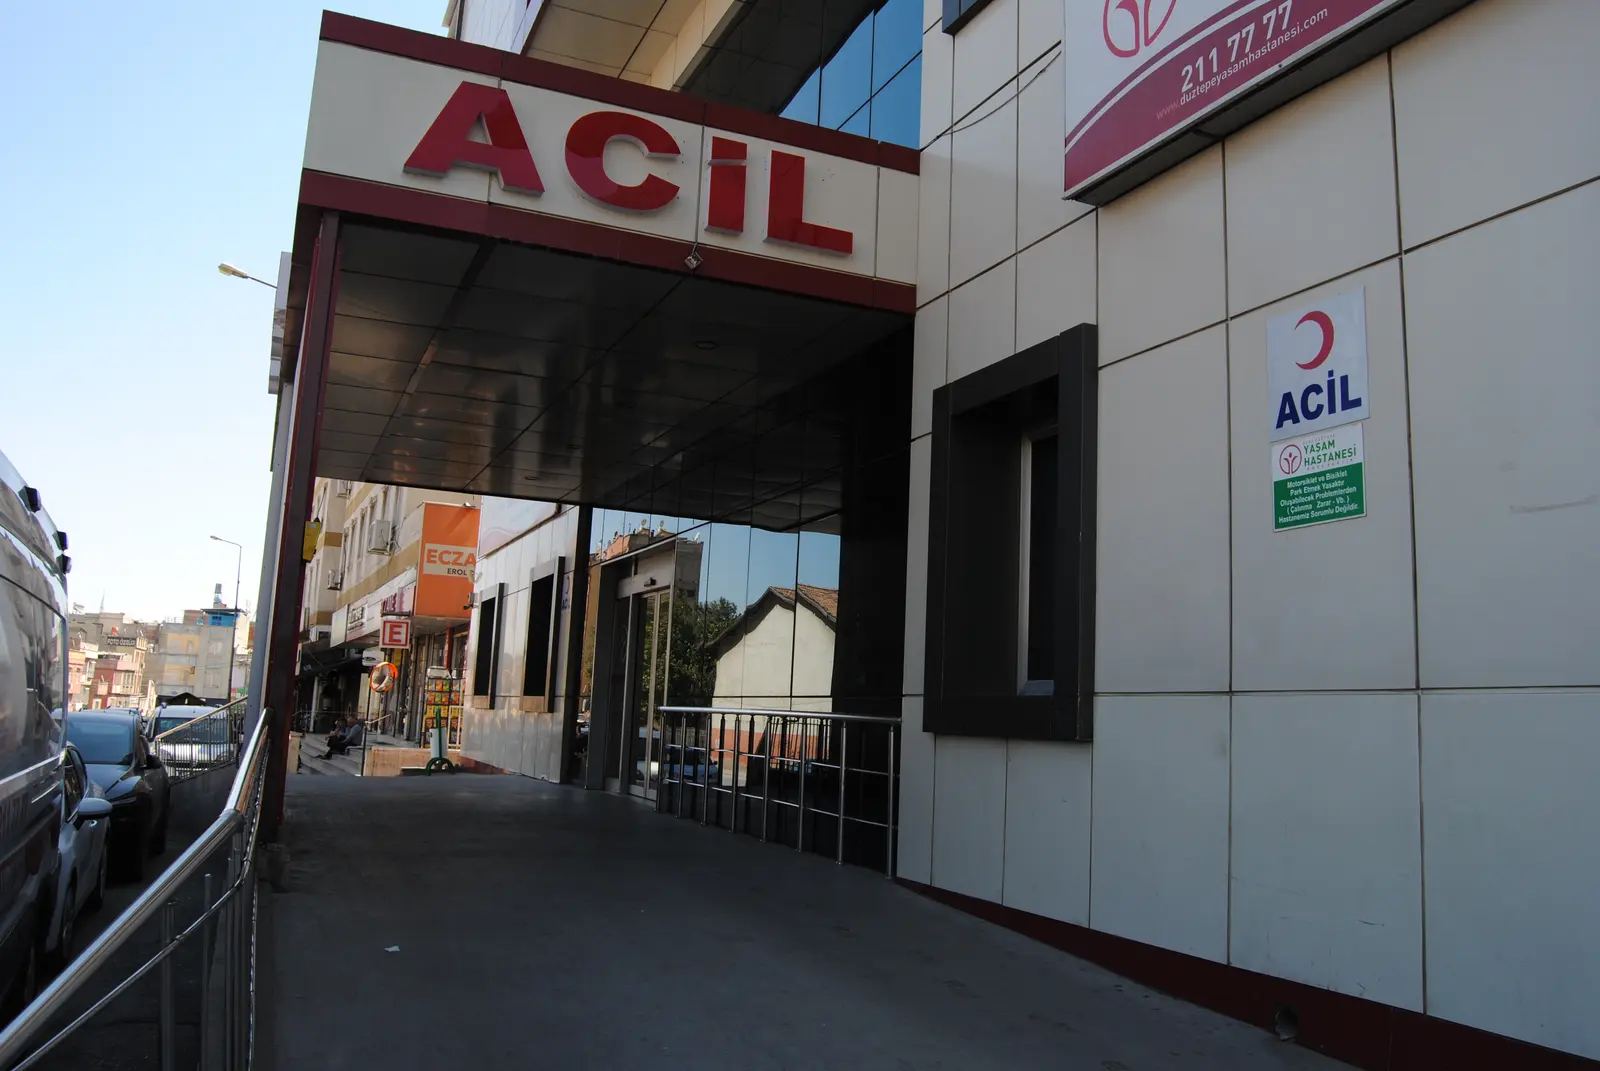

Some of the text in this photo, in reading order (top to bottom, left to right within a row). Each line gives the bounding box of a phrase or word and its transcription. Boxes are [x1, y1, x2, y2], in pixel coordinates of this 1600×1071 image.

[1181, 0, 1293, 93] 211 77 77
[403, 80, 854, 256] ACİL
[1275, 369, 1362, 429] ACİL
[1303, 439, 1336, 455] YAŞAM
[1304, 444, 1357, 467] HASTANESİ
[1287, 476, 1318, 489] Motorsiklet
[1325, 470, 1348, 480] Bisiklet
[1290, 480, 1345, 496] Park Etmek Yasaktır
[1280, 486, 1357, 507] Oluşabilecek Problemlerden
[1317, 499, 1332, 508] Zarar
[1278, 512, 1310, 524] Hastanemiz
[1310, 507, 1334, 518] Sorumlu
[447, 568, 467, 576] EROL
[389, 624, 402, 643] E
